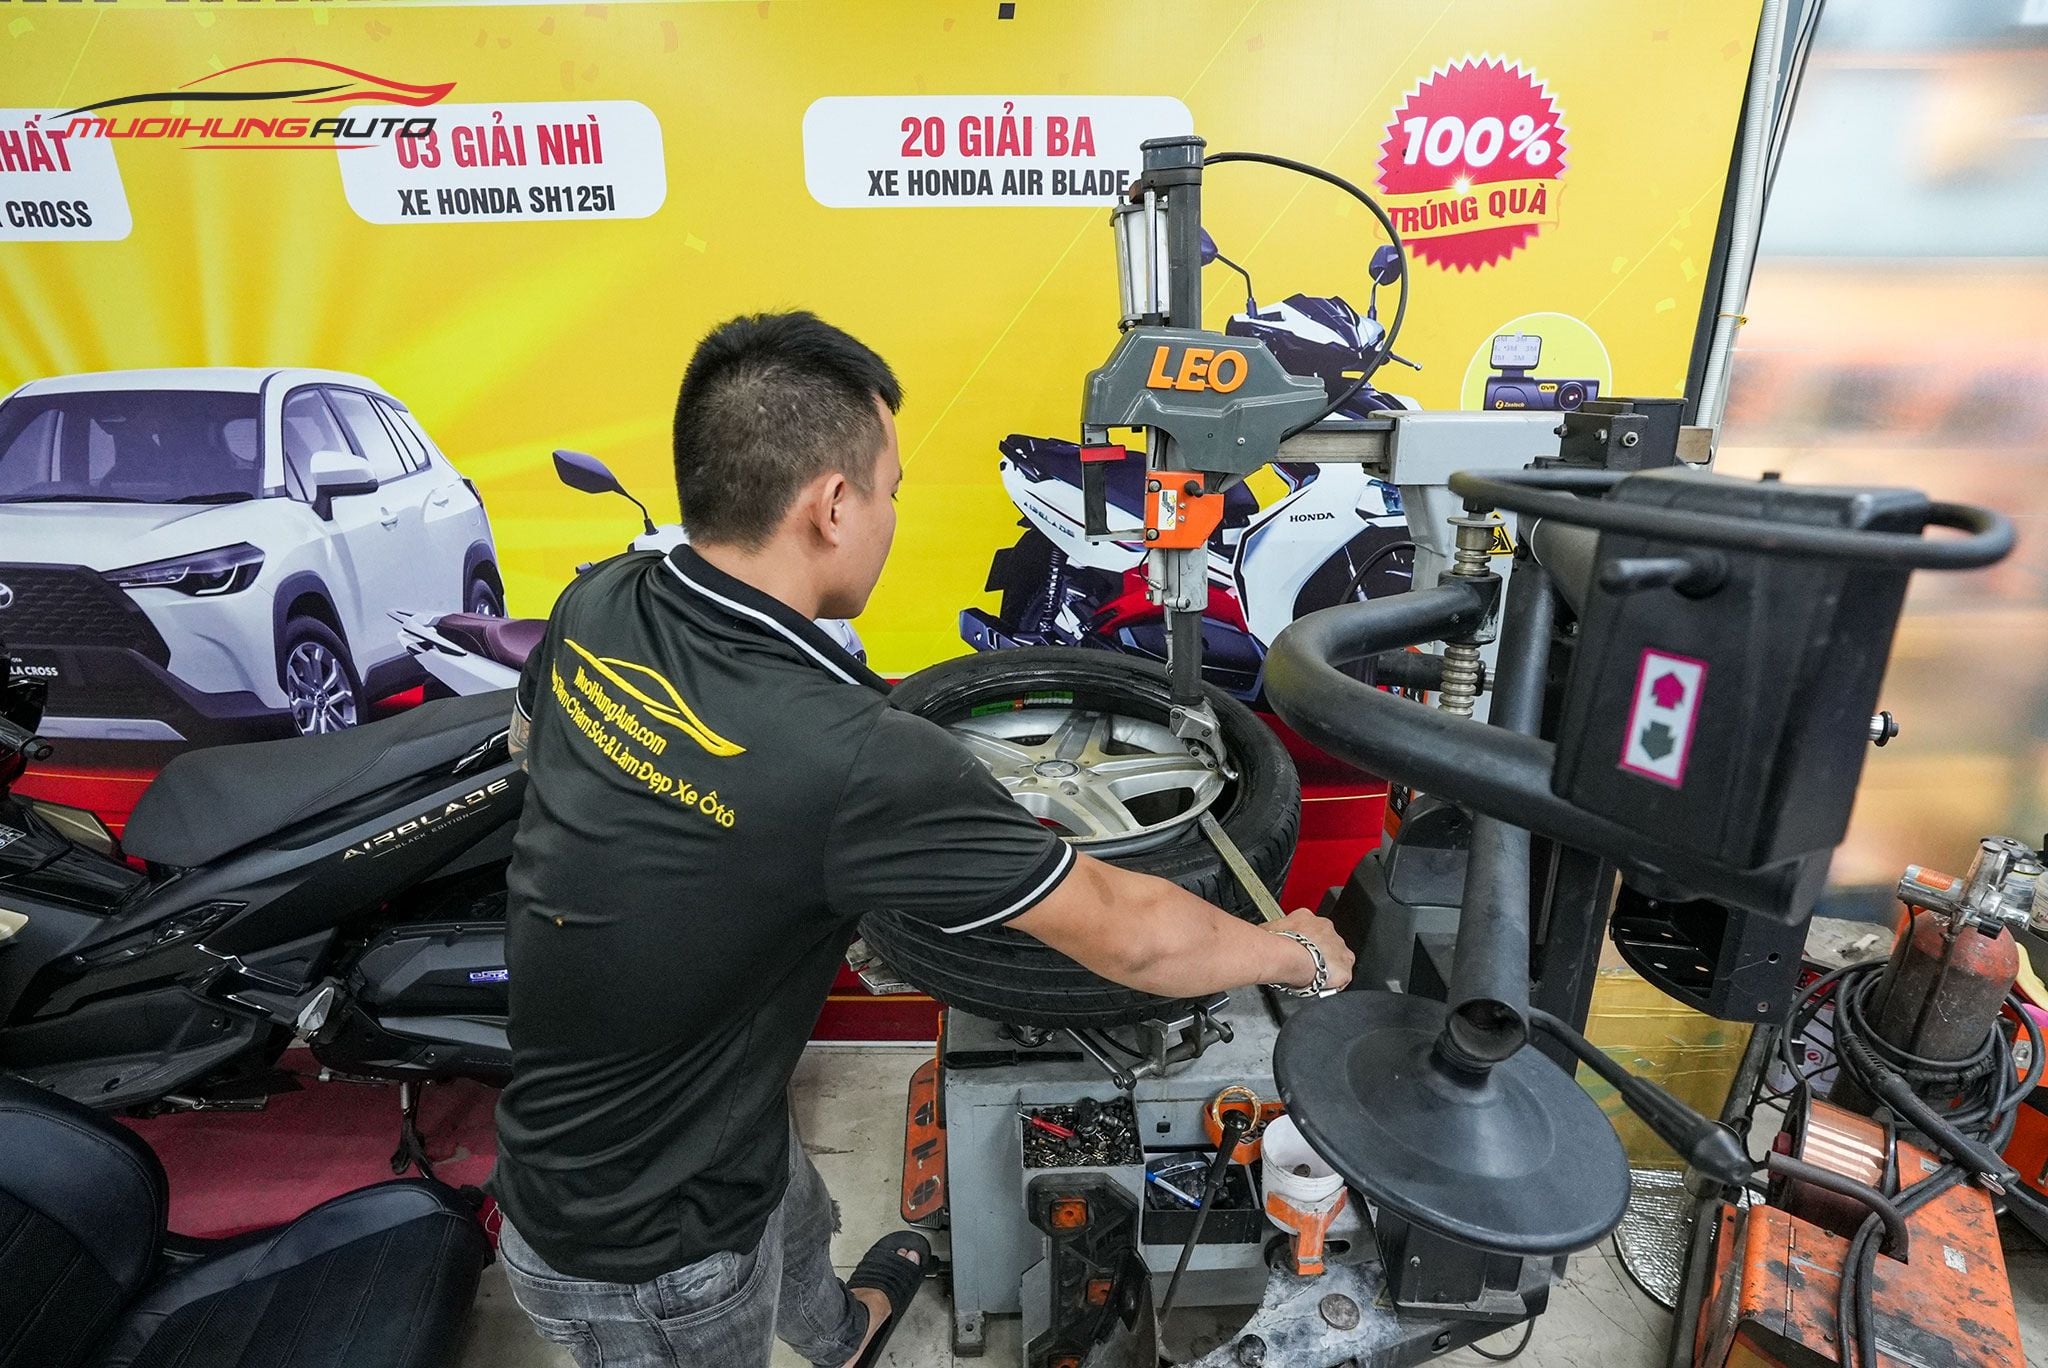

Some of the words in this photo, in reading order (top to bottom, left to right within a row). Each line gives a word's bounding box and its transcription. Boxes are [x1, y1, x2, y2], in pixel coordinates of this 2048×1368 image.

[0, 114, 72, 172] HẤT
[394, 127, 442, 169] 03
[451, 111, 528, 168] GIẢI
[537, 114, 603, 165] NHÌ
[901, 116, 945, 157] 20
[958, 101, 1033, 158] GIẢI
[1046, 116, 1096, 157] BA
[1403, 114, 1551, 167] 100%
[398, 188, 431, 216] XE
[437, 187, 523, 215] HONDA
[528, 185, 616, 213] SH125I
[867, 169, 898, 197] XE
[908, 169, 994, 196] HONDA
[1001, 169, 1044, 195] AIR
[1052, 169, 1130, 196] BLADE
[5, 200, 93, 228] CROSS
[1387, 196, 1479, 233] TRÚNG
[1488, 183, 1547, 218] QUÀ
[1146, 345, 1249, 394] LEO
[1290, 512, 1335, 522] HONDA
[24, 666, 59, 676] CROSS
[670, 779, 699, 806] Xe
